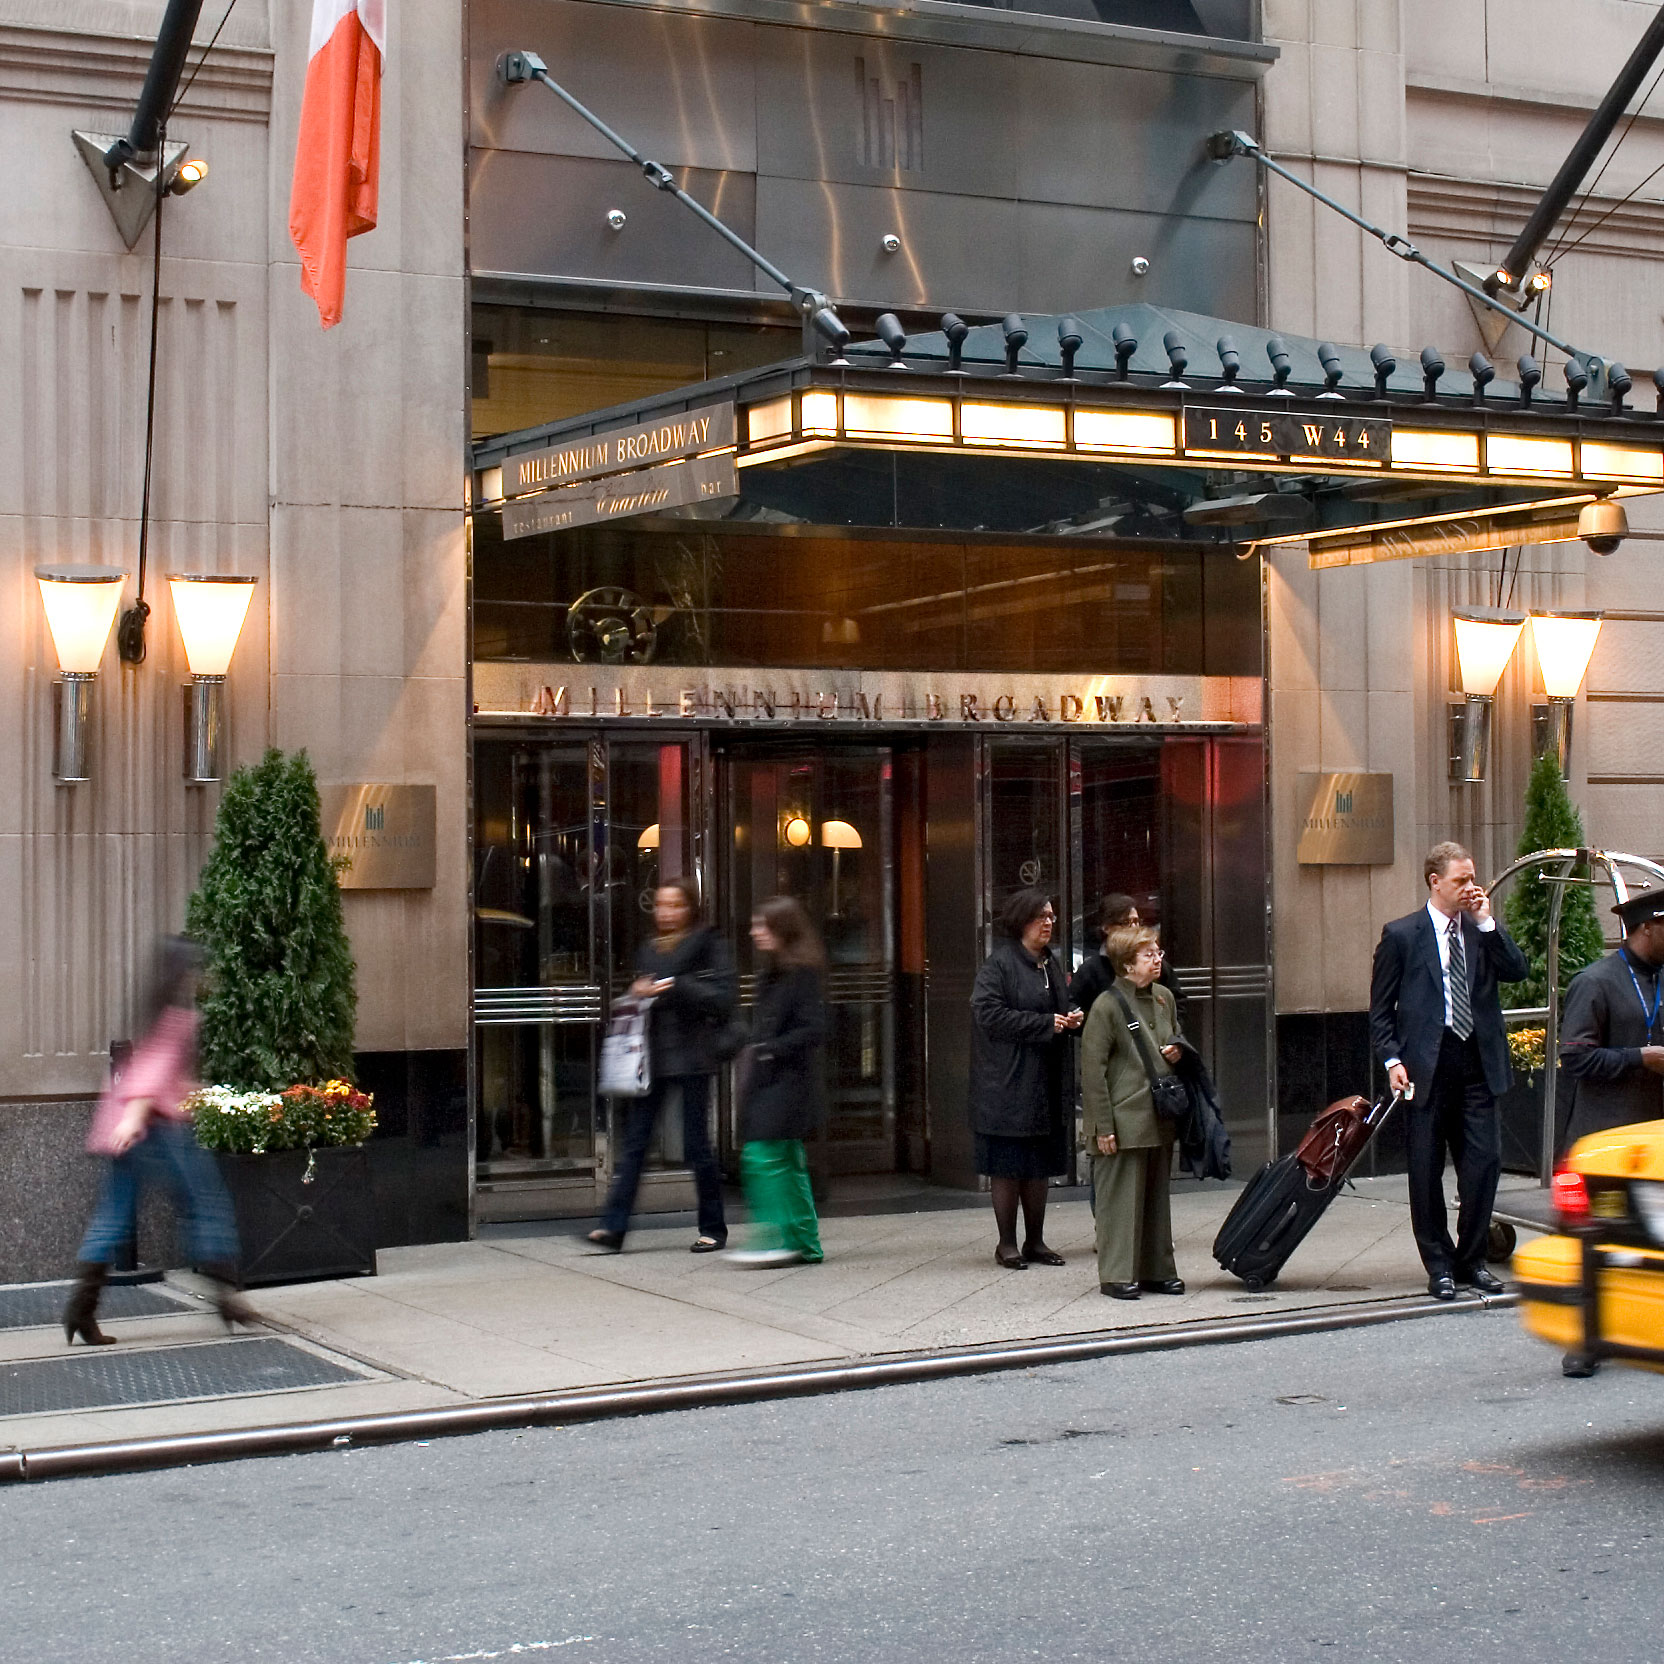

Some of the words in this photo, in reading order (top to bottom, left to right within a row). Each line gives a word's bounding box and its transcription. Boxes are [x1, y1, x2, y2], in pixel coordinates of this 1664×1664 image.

[1209, 418, 1273, 443] 145
[1302, 424, 1370, 449] W44
[519, 442, 609, 485] MILLENNIUM
[617, 417, 711, 462] BROADWAY
[535, 686, 882, 721] MILLENNIUM
[926, 692, 1184, 722] BROADWAY
[1303, 818, 1385, 829] MILLENNIUM
